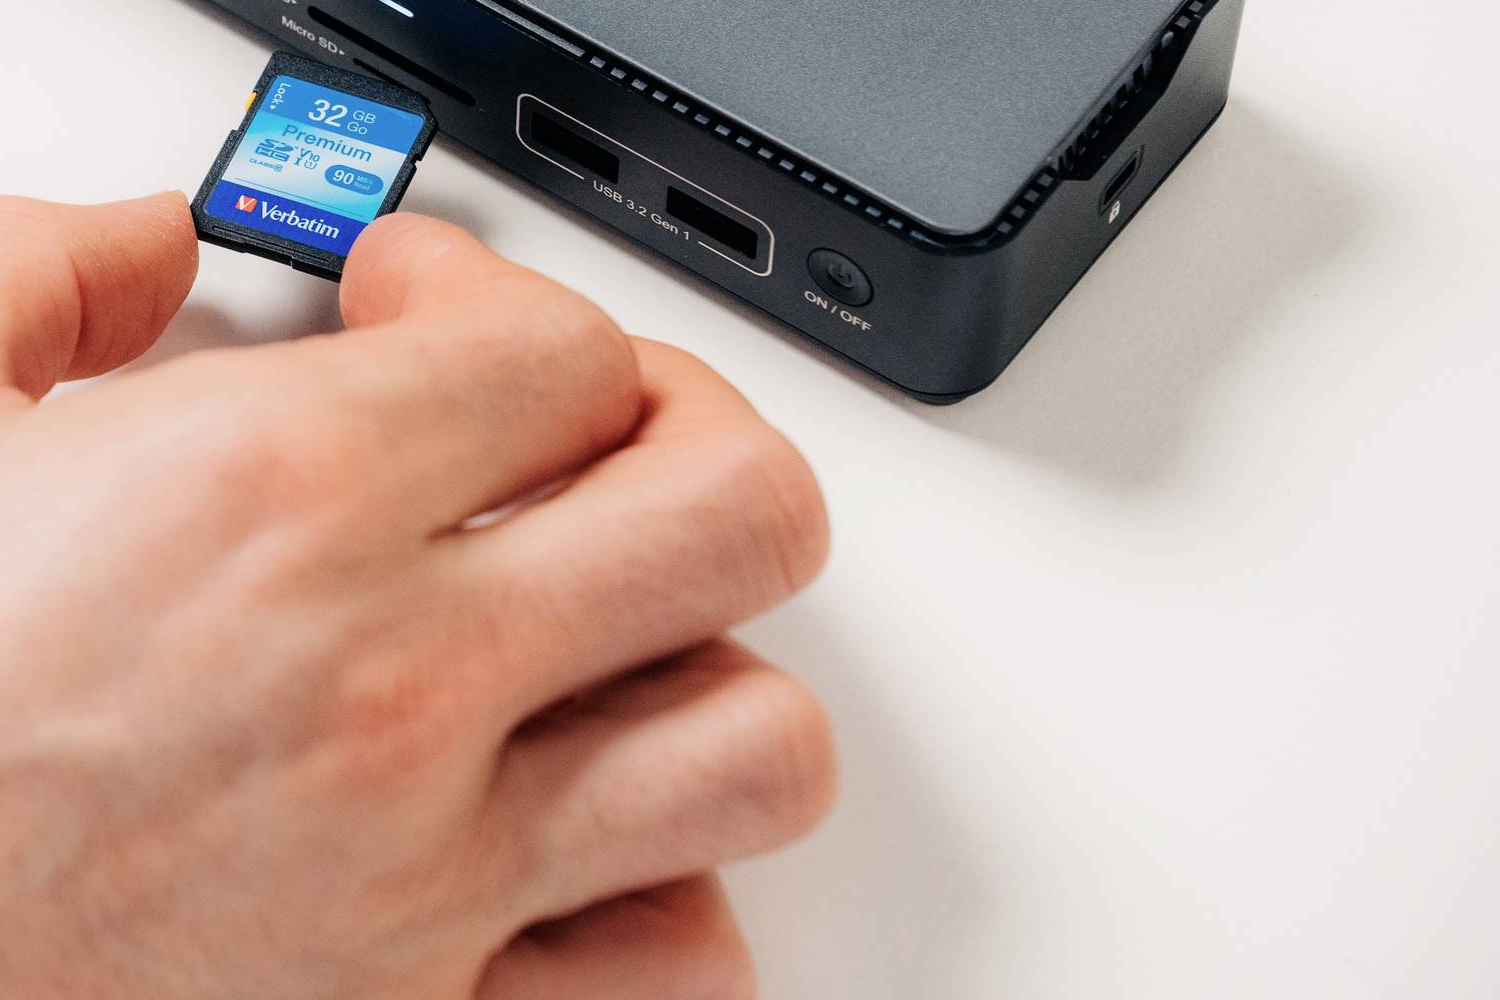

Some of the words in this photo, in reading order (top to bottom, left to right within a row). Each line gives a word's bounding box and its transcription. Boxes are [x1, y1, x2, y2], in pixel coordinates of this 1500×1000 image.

[281, 15, 317, 42] Micro
[318, 36, 338, 55] SD
[270, 82, 292, 105] Lock
[308, 98, 348, 128] 32
[352, 110, 377, 124] GB
[346, 121, 368, 135] Go
[282, 124, 373, 163] Premium
[332, 169, 355, 185] 90
[261, 201, 340, 239] Verbatim
[593, 180, 623, 204] USB
[626, 197, 647, 218] 3.2
[651, 213, 679, 235] Gen
[683, 231, 691, 241] 1
[803, 290, 828, 310] ON
[840, 309, 873, 333] OFF
